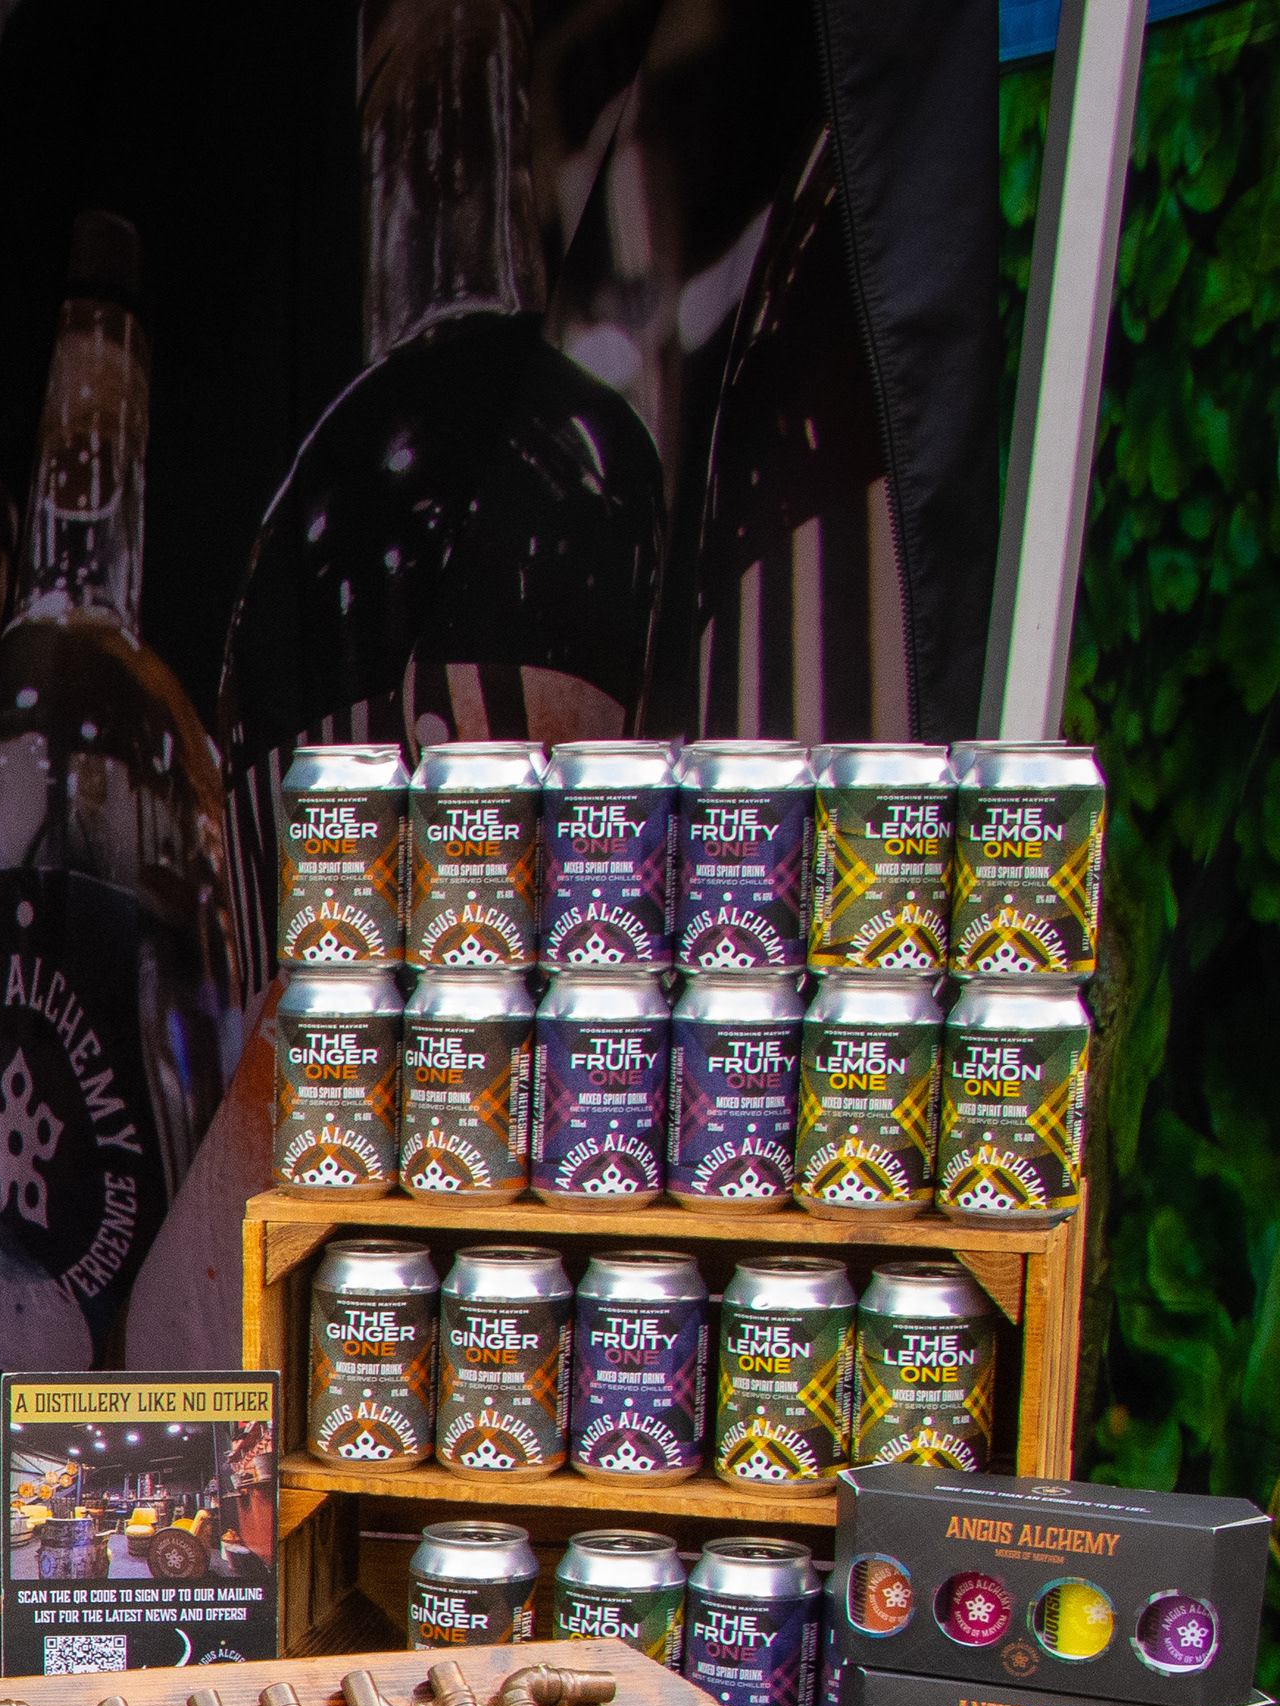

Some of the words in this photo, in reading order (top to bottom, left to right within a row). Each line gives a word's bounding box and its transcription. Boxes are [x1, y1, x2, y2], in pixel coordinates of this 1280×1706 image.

[305, 807, 356, 823] THE
[446, 809, 499, 825] THE
[573, 806, 626, 822] THE
[705, 809, 759, 825] THE
[887, 806, 940, 822] THE
[986, 808, 1043, 824] THE
[290, 824, 378, 839] GINGER
[427, 825, 520, 841] GINGER
[557, 821, 646, 838] FRUITY
[690, 825, 779, 841] FRUITY
[865, 822, 951, 839] LEMON
[970, 825, 1065, 841] LEMON
[304, 838, 358, 854] ONE
[446, 841, 502, 856] ONE
[572, 838, 628, 854] ONE
[704, 841, 760, 857] ONE
[884, 839, 939, 855] ONE
[983, 842, 1043, 858] ONE
[306, 1034, 357, 1049] THE
[416, 1037, 463, 1053] THE
[590, 1038, 644, 1054] THE
[728, 1041, 782, 1057] THE
[832, 1041, 886, 1058] THE
[289, 1049, 378, 1065] GINGER
[405, 1051, 486, 1069] GINGER
[571, 1054, 657, 1070] FRUITY
[967, 1047, 1021, 1064] THE
[304, 1064, 358, 1079] ONE
[708, 1056, 797, 1073] FRUITY
[815, 1056, 907, 1074] LEMON
[952, 1062, 1043, 1081] LEMON
[415, 1067, 464, 1084] ONE
[589, 1071, 643, 1085] ONE
[726, 1073, 782, 1089] ONE
[829, 1074, 886, 1091] ONE
[963, 1080, 1021, 1097] ONE
[345, 1310, 396, 1327] THE
[466, 1317, 518, 1334] THE
[606, 1318, 660, 1335] THE
[326, 1323, 416, 1342] GINGER
[450, 1330, 539, 1350] GINGER
[591, 1331, 679, 1350] FRUITY
[740, 1324, 791, 1343] THE
[344, 1341, 396, 1356] ONE
[727, 1337, 811, 1359] LEMON
[903, 1335, 959, 1351] THE
[465, 1347, 518, 1364] ONE
[605, 1349, 661, 1365] ONE
[884, 1349, 977, 1367] LEMON
[738, 1356, 791, 1374] ONE
[900, 1366, 959, 1383] ONE
[15, 1393, 28, 1413] A
[35, 1393, 131, 1413] DISTILLERY
[138, 1392, 176, 1413] LIKE
[183, 1391, 207, 1412] NO
[213, 1391, 269, 1412] OTHER
[945, 1516, 1014, 1545] ANGUS
[1018, 1524, 1121, 1556] ALCHEMY
[17, 1590, 48, 1604] SCAN
[50, 1590, 72, 1603] THE
[73, 1590, 89, 1604] QR
[90, 1589, 117, 1603] CODE
[119, 1589, 132, 1602] TO
[134, 1589, 160, 1602] SIGN
[161, 1589, 176, 1602] UP
[178, 1589, 191, 1602] TO
[193, 1588, 215, 1601] OUR
[216, 1587, 264, 1601] MAILING
[421, 1592, 467, 1614] THE
[34, 1610, 57, 1623] LIST
[58, 1610, 80, 1623] FOR
[82, 1609, 104, 1623] THE
[105, 1609, 144, 1623] LATEST
[145, 1608, 178, 1622] NEWS
[179, 1608, 203, 1621] AND
[205, 1607, 249, 1621] OFFERS!
[410, 1604, 489, 1630] GINGER
[573, 1603, 621, 1624] THE
[707, 1611, 758, 1632] THE
[421, 1623, 467, 1644] ONE
[560, 1612, 639, 1638] LEMON
[693, 1623, 778, 1648] FRUITY
[706, 1644, 758, 1662] ONE
